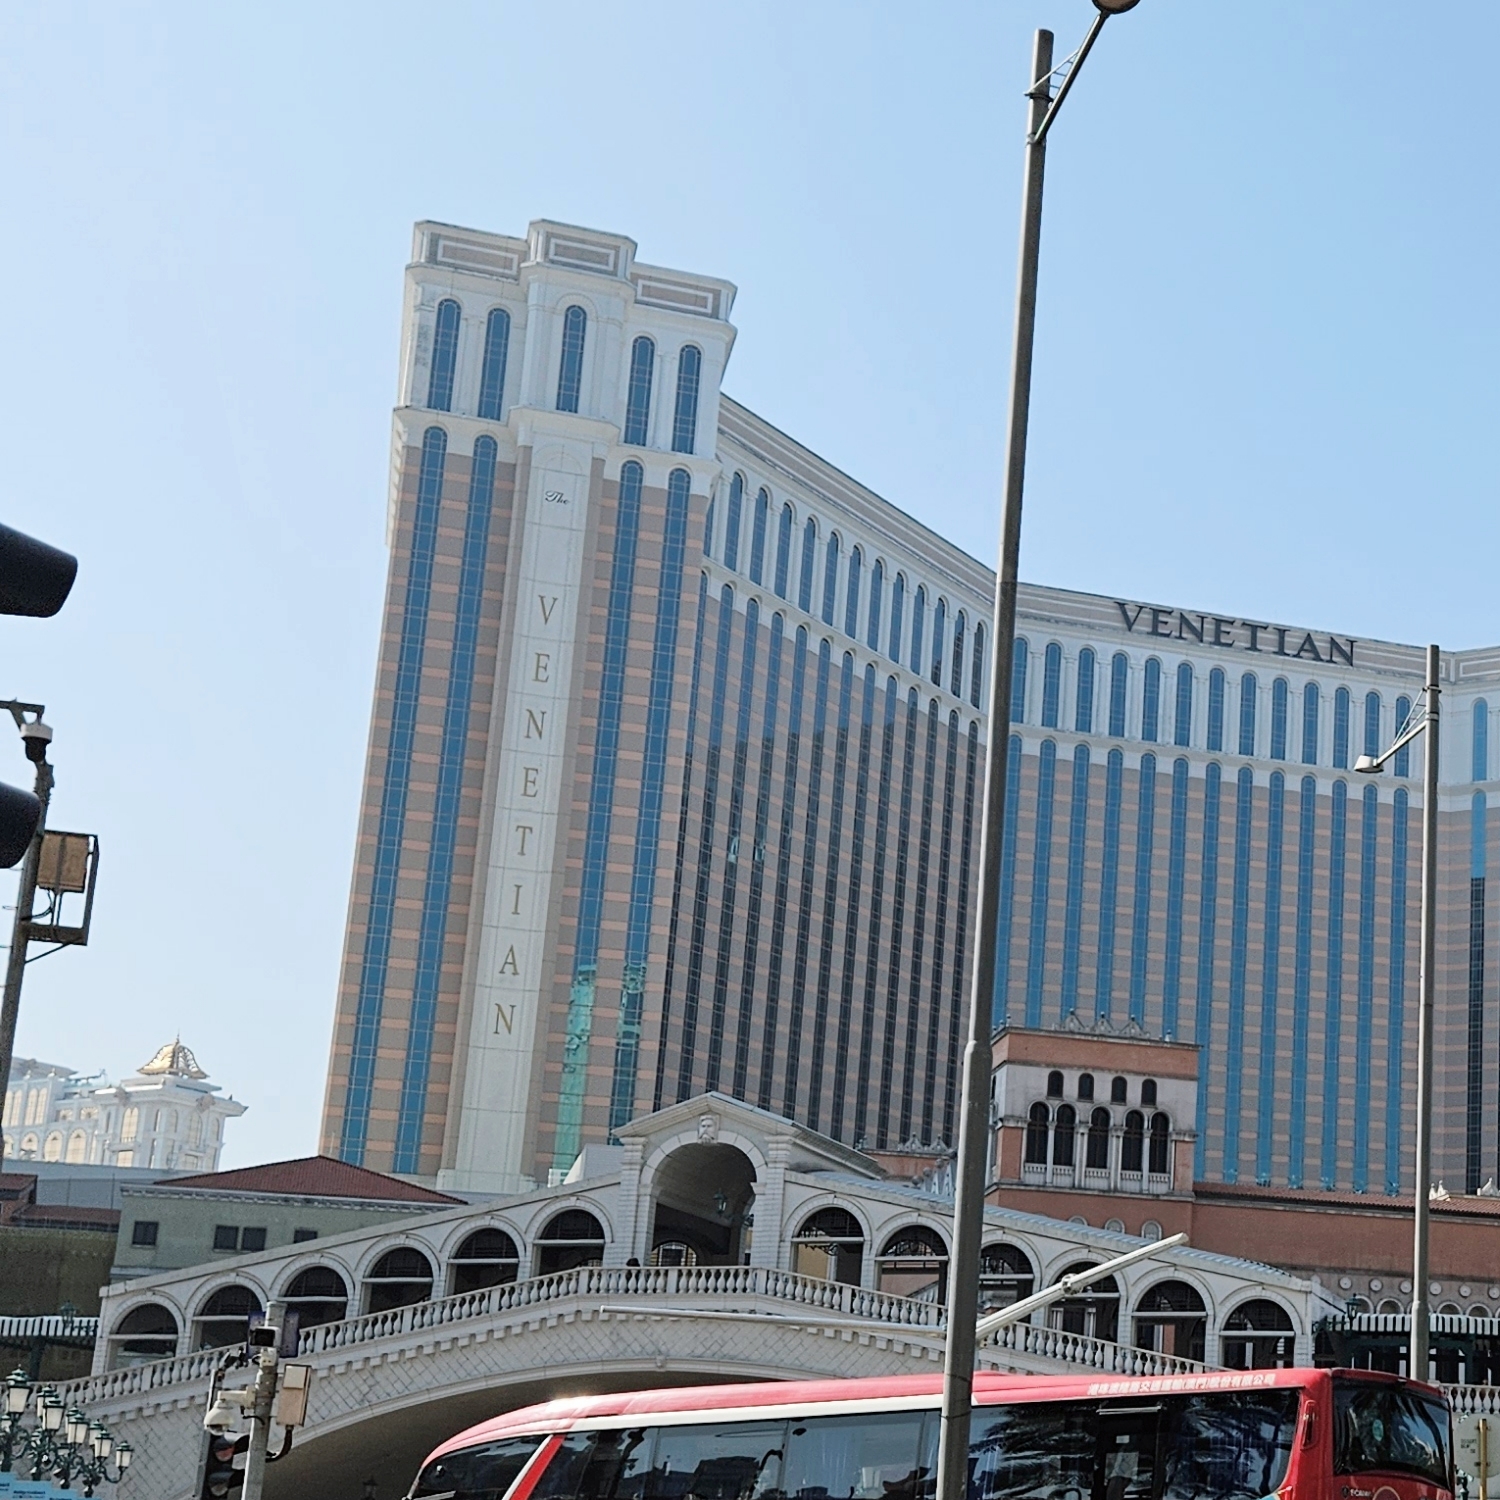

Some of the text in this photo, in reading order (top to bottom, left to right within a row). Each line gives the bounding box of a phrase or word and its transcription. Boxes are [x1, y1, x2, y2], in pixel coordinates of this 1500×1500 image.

[544, 489, 570, 506] The
[1113, 600, 1359, 668] VENETIAN
[493, 594, 559, 1036] VENETIAN
